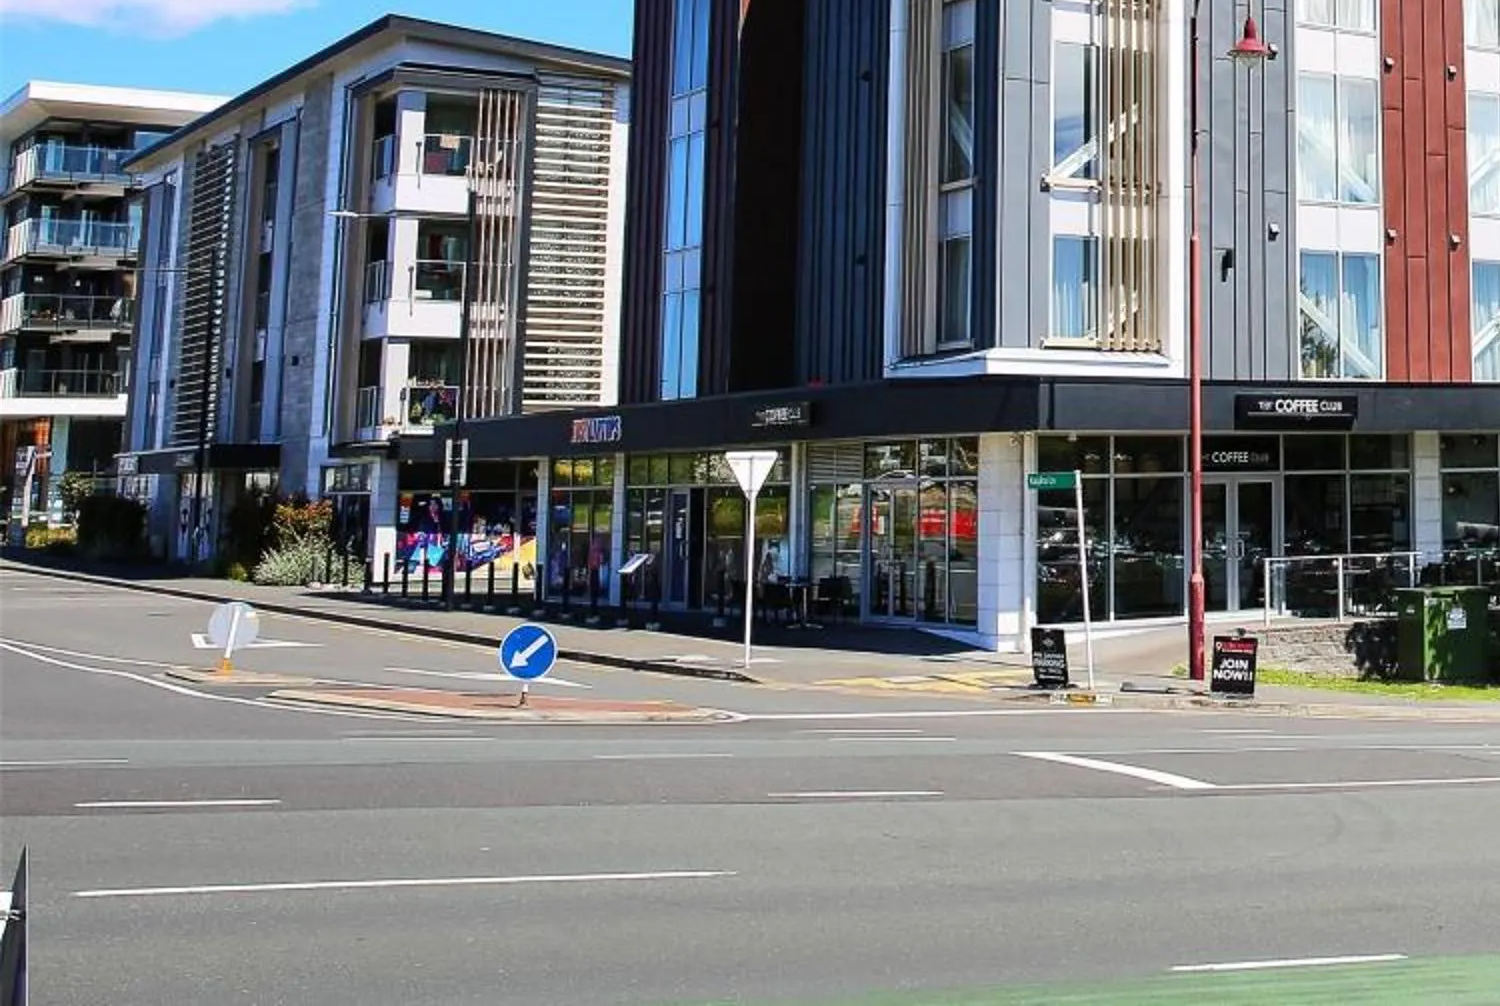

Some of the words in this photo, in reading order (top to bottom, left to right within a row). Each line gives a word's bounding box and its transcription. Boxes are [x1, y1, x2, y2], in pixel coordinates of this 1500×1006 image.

[1275, 399, 1319, 413] COFFEE
[1211, 451, 1249, 463] COFFEE
[1220, 658, 1249, 670] JOIN
